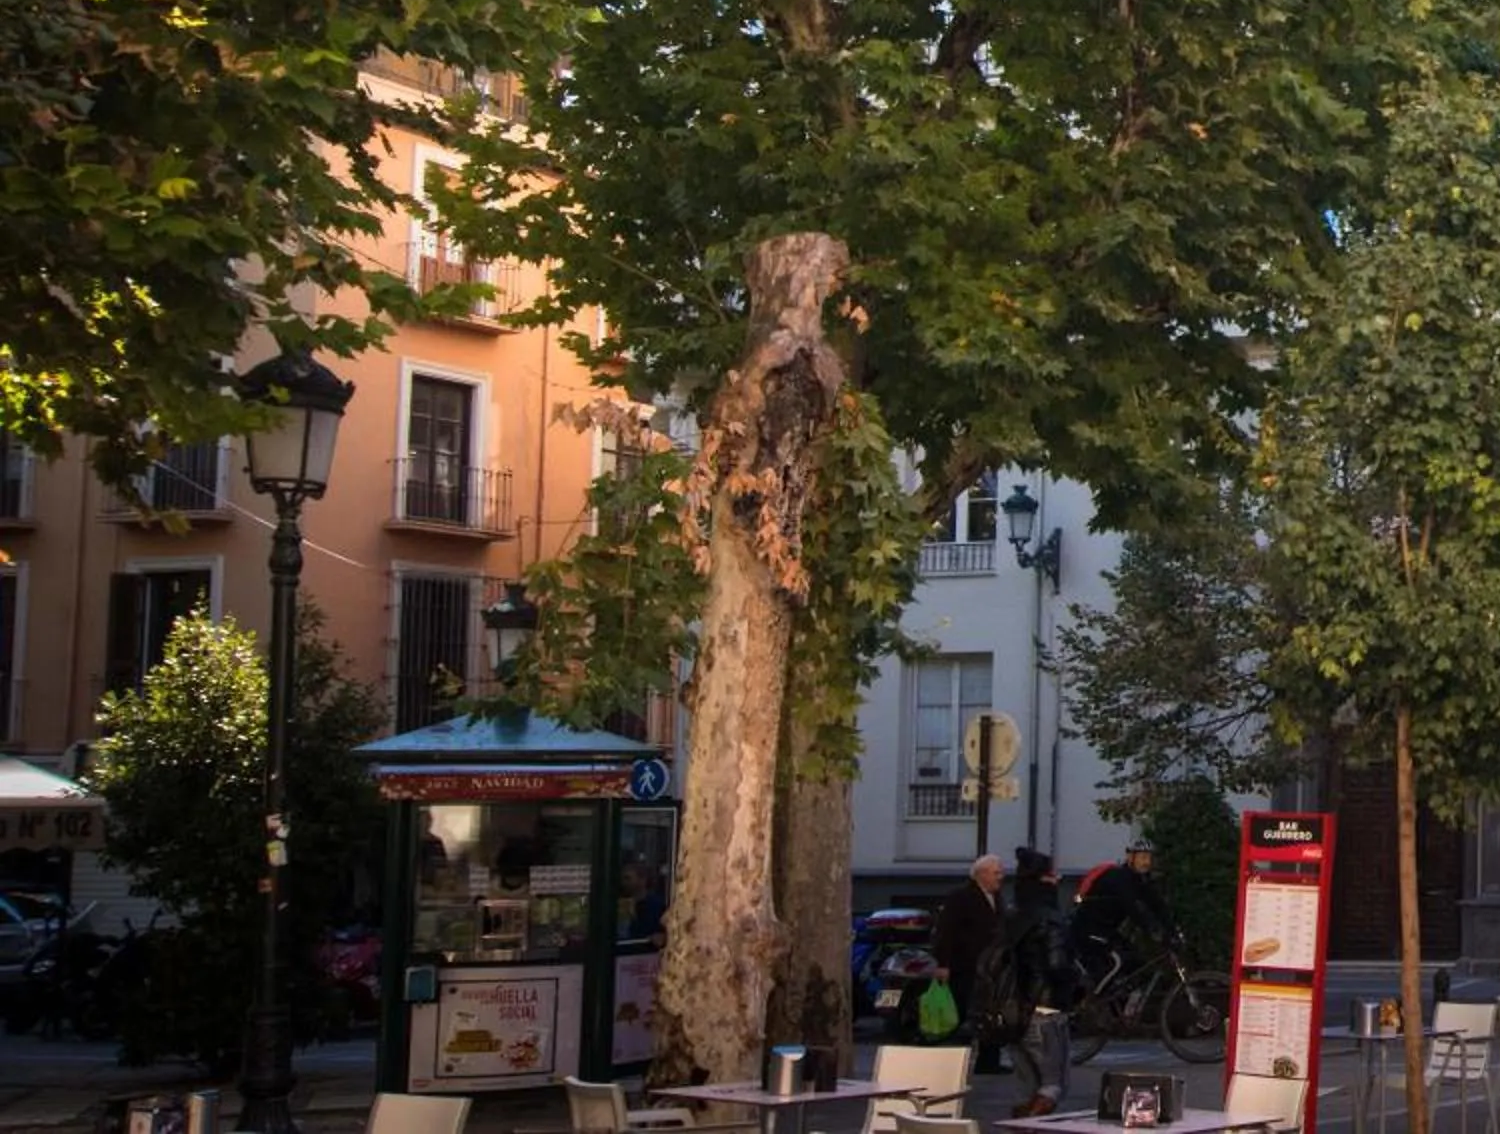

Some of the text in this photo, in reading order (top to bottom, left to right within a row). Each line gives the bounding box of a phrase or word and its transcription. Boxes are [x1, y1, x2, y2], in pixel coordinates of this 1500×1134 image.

[471, 777, 544, 789] NAVIDAD
[55, 811, 92, 839] 102
[1263, 830, 1313, 841] GUERRERO
